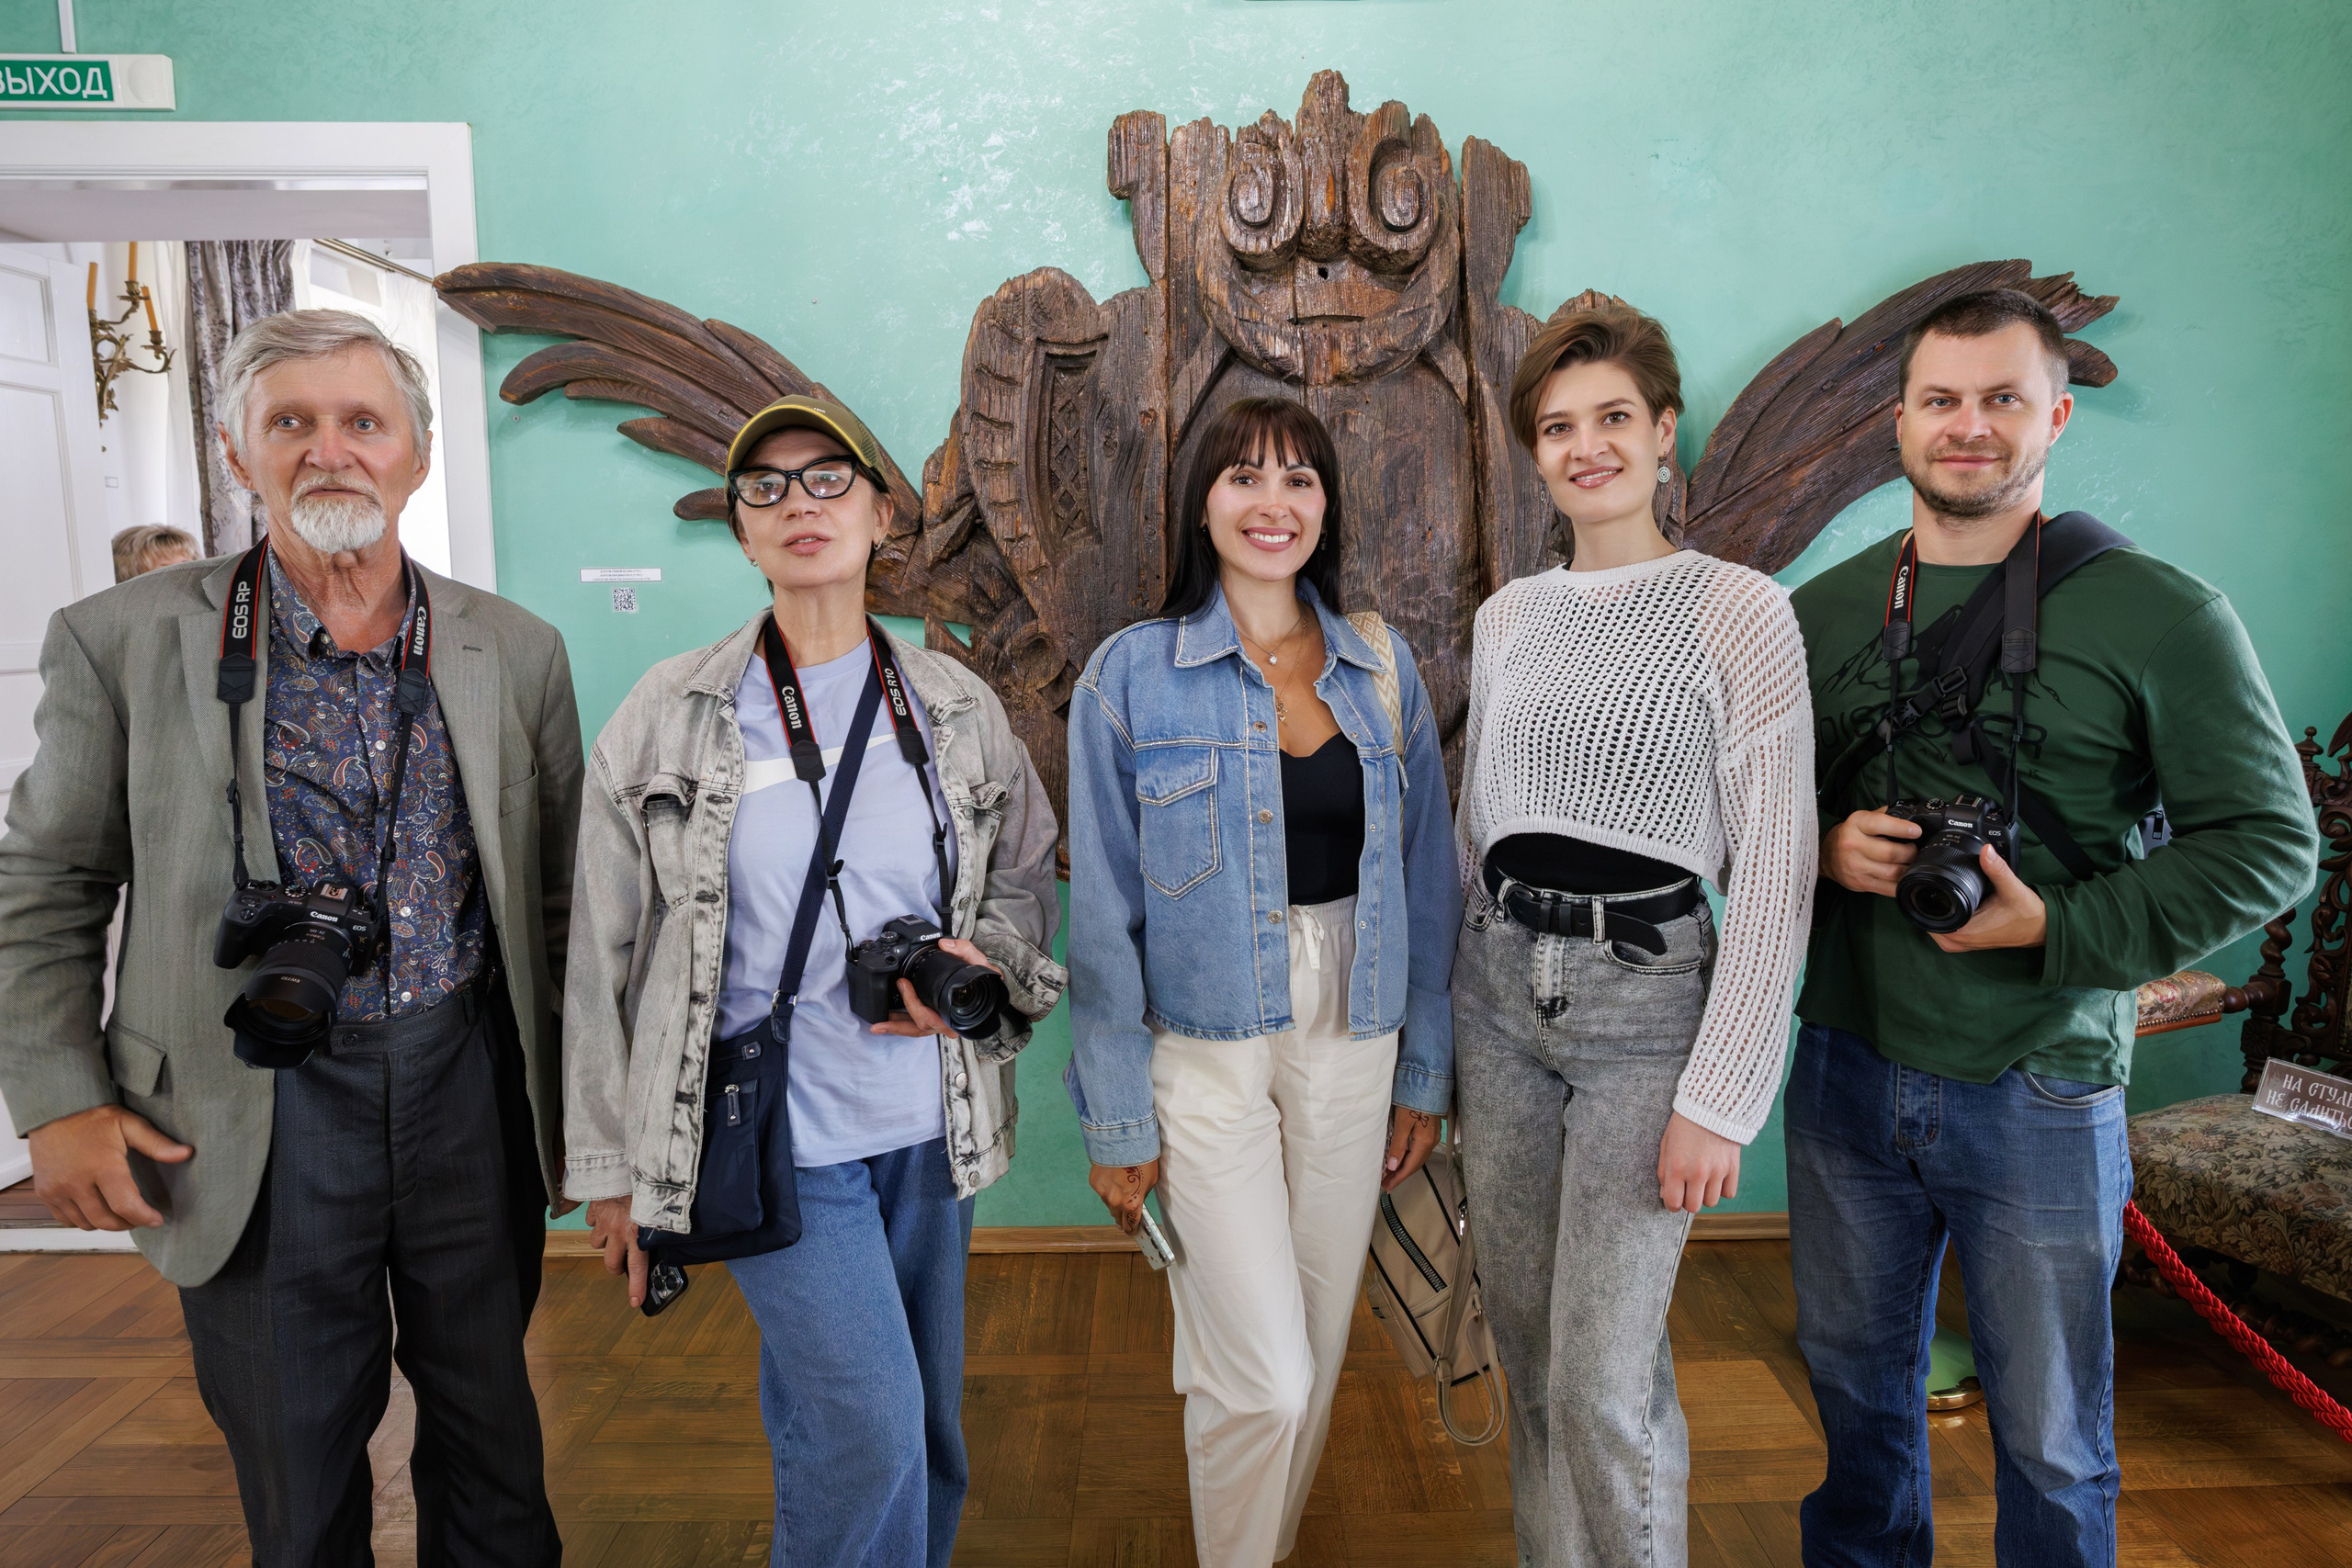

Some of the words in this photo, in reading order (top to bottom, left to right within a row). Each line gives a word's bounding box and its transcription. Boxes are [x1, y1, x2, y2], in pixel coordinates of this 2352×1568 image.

[235, 581, 251, 603] RP
[1894, 565, 1909, 609] Canon
[232, 604, 249, 639] EOS
[413, 605, 427, 656] Canon
[884, 668, 898, 687] R10
[781, 685, 803, 729] Canon
[889, 688, 907, 716] EOS
[1819, 705, 2049, 761] DISOER
[1948, 818, 1973, 829] Canon
[310, 910, 339, 922] Canon
[920, 931, 941, 942] Canon
[2282, 1073, 2303, 1093] НА
[2266, 1089, 2287, 1108] НЕ
